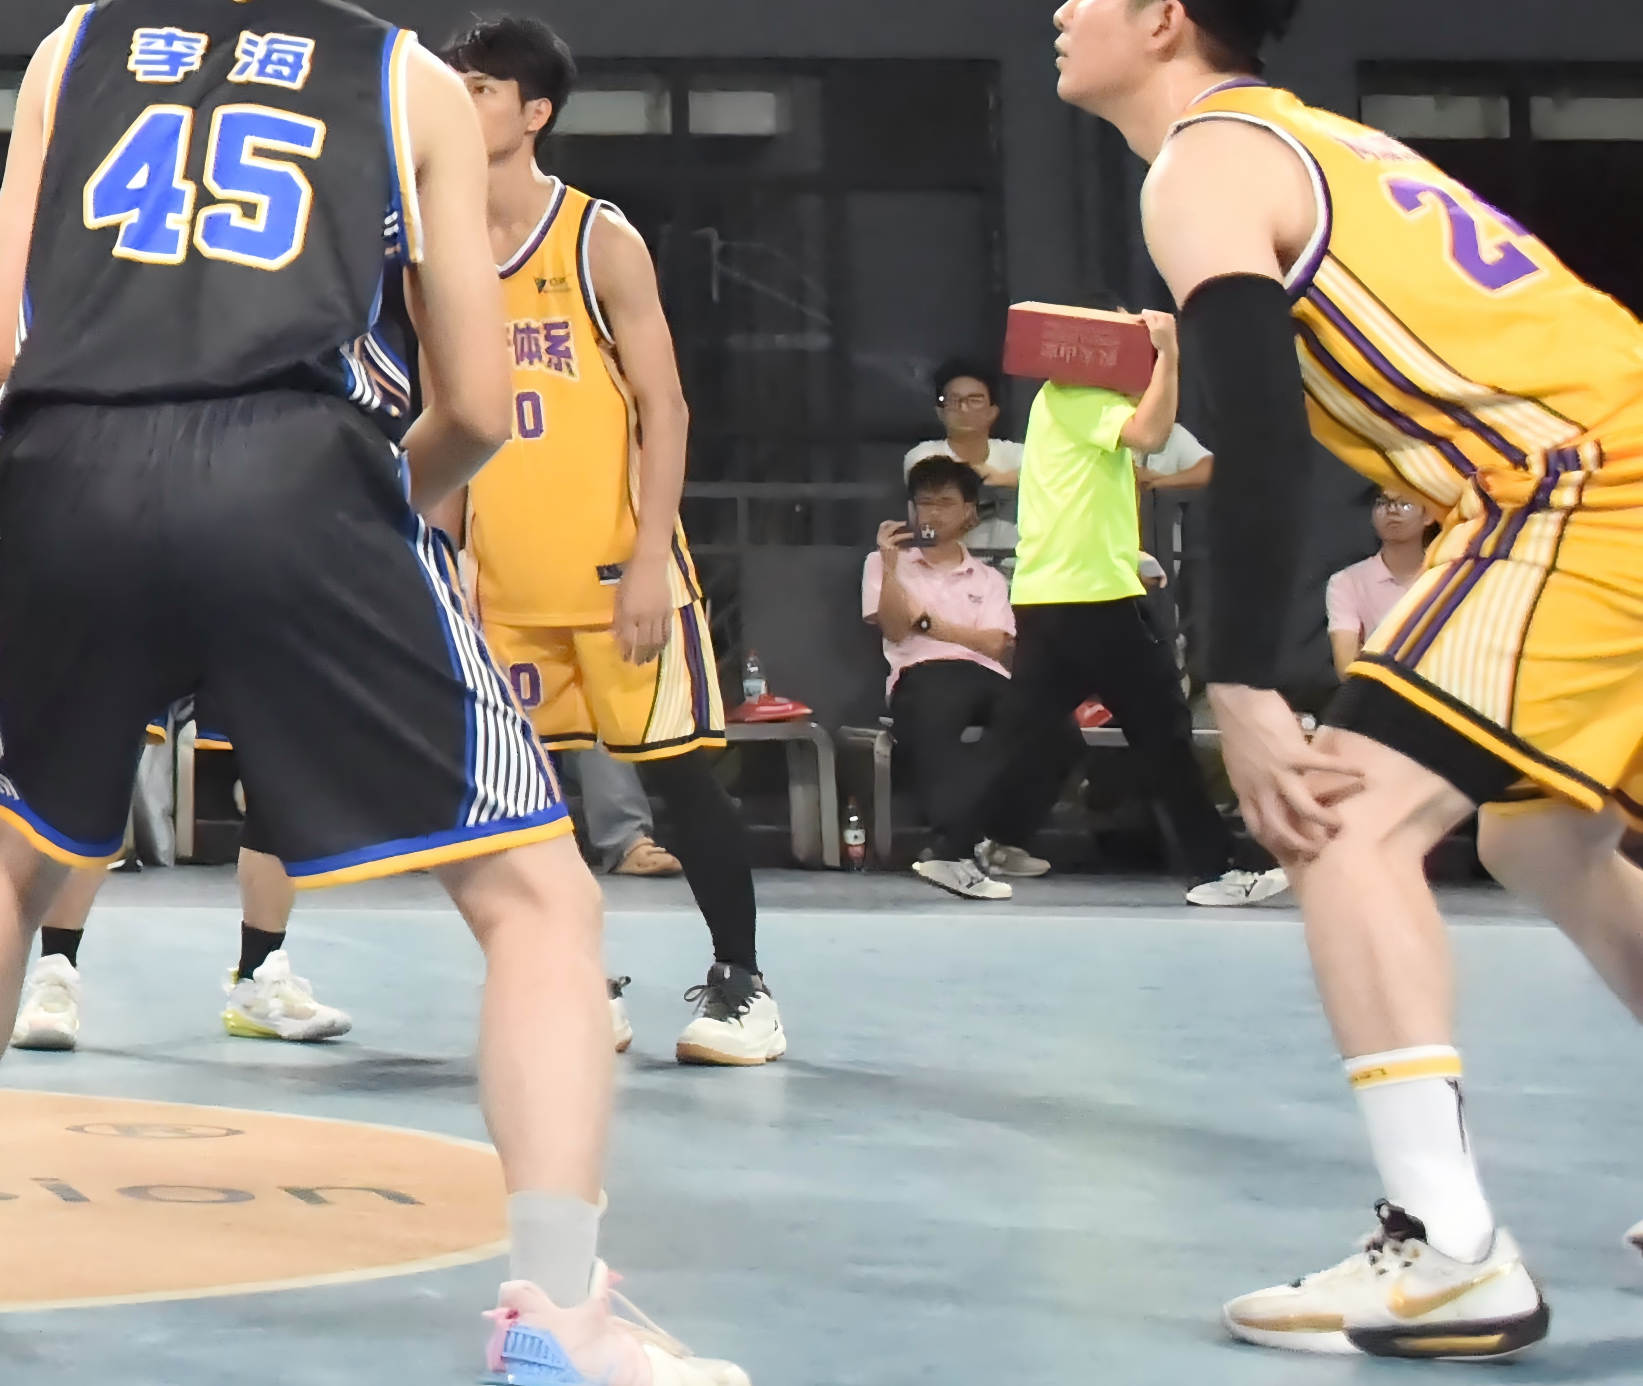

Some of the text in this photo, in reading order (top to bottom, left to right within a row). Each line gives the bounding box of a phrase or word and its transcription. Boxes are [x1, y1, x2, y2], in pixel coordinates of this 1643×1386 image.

[127, 27, 315, 91] 李海
[83, 103, 327, 271] 45
[1379, 174, 1549, 298] 2
[505, 317, 579, 381] 体系
[513, 389, 546, 440] 0
